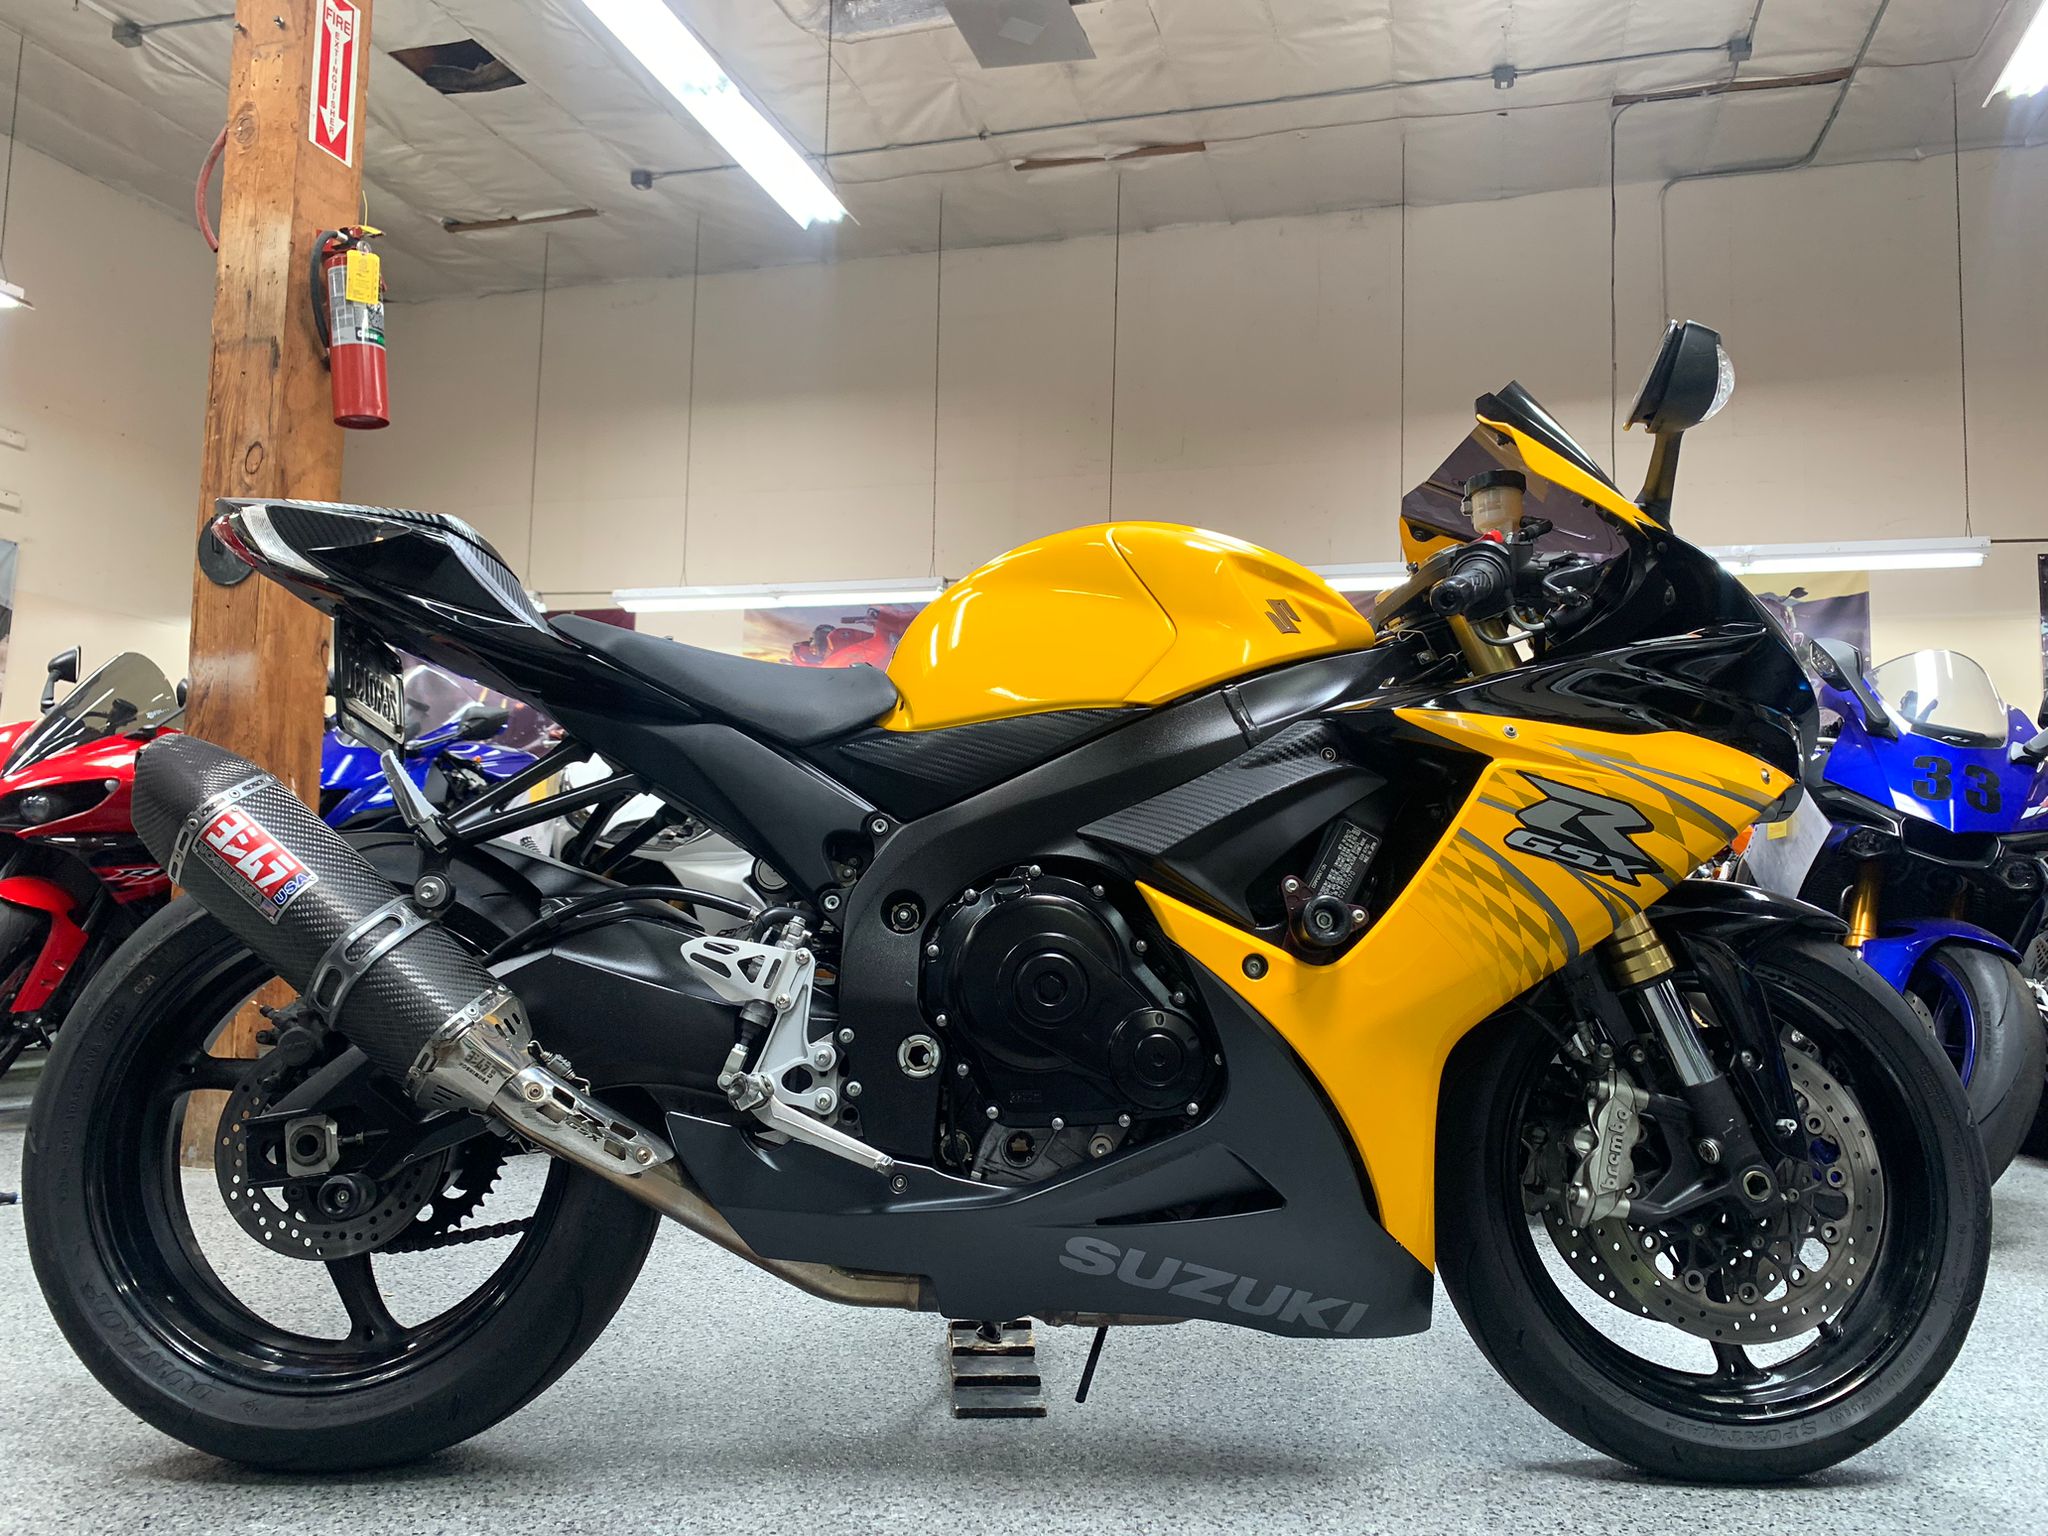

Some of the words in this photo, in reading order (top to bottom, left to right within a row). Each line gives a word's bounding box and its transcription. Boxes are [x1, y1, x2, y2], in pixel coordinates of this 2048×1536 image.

[326, 7, 351, 36] FIRE
[329, 32, 341, 135] EXTINGUISHER
[1516, 770, 1654, 871] R
[1912, 756, 2002, 814] 33
[206, 811, 297, 889] ヨシムラ
[273, 872, 310, 905] USA
[1504, 828, 1648, 886] GSX
[1600, 1109, 1629, 1190] brembo
[1059, 1236, 1370, 1334] SUZUKI
